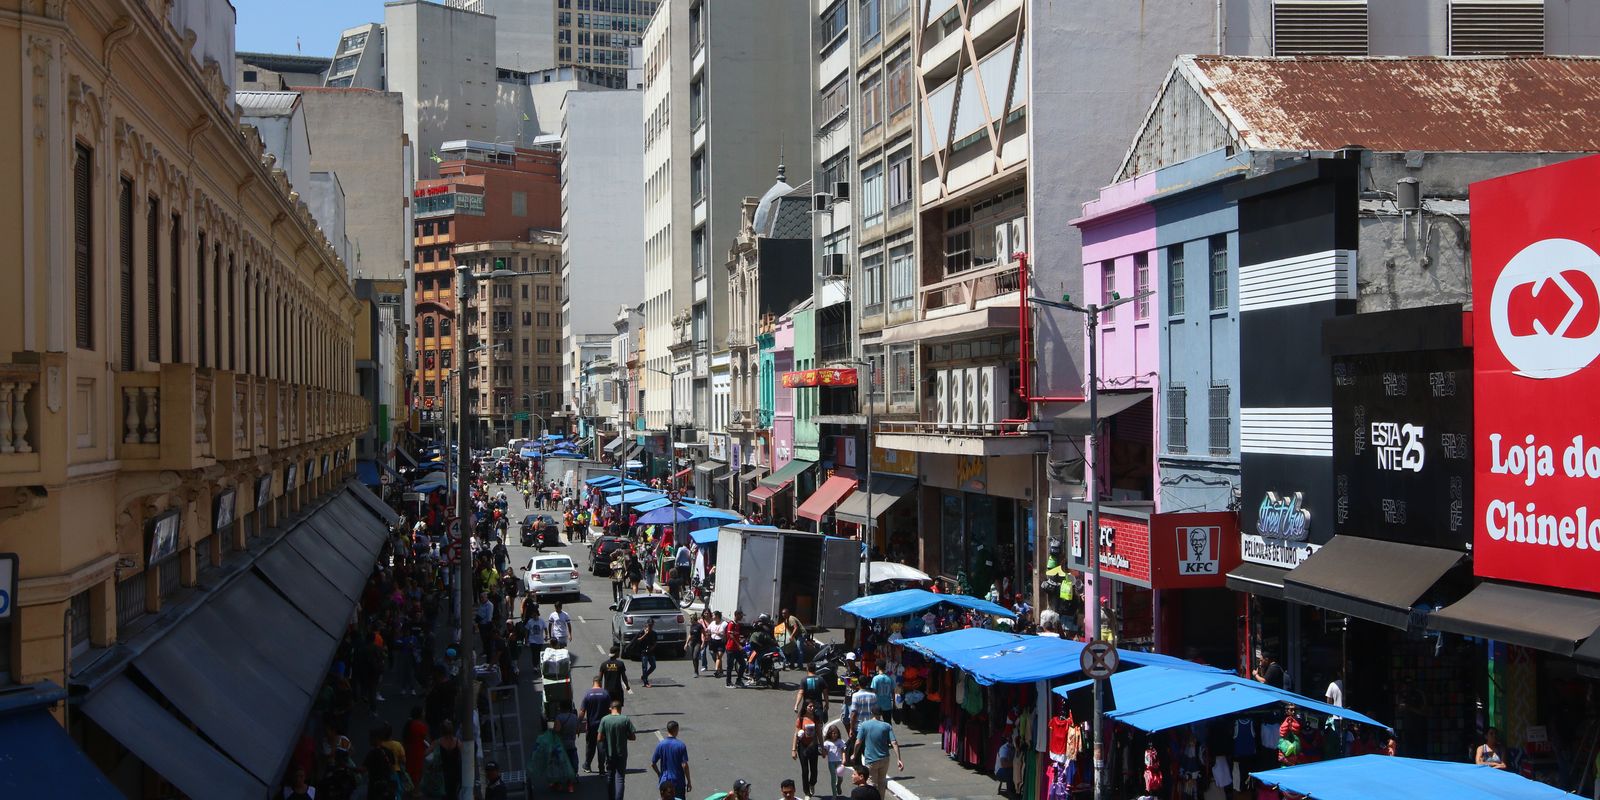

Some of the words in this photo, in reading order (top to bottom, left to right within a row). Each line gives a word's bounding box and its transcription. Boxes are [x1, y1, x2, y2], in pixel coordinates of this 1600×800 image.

[1371, 422, 1402, 446] ESTA
[1402, 422, 1425, 472] 25
[1378, 447, 1402, 470] NTE
[1489, 433, 1555, 487] Loja
[1562, 434, 1600, 479] do
[1100, 526, 1114, 548] FC
[1486, 499, 1600, 552] Chinelo
[1244, 537, 1272, 561] PELÍCULAS
[1272, 546, 1280, 562] DE
[1280, 546, 1298, 565] VIDRO
[1185, 562, 1213, 574] KFC
